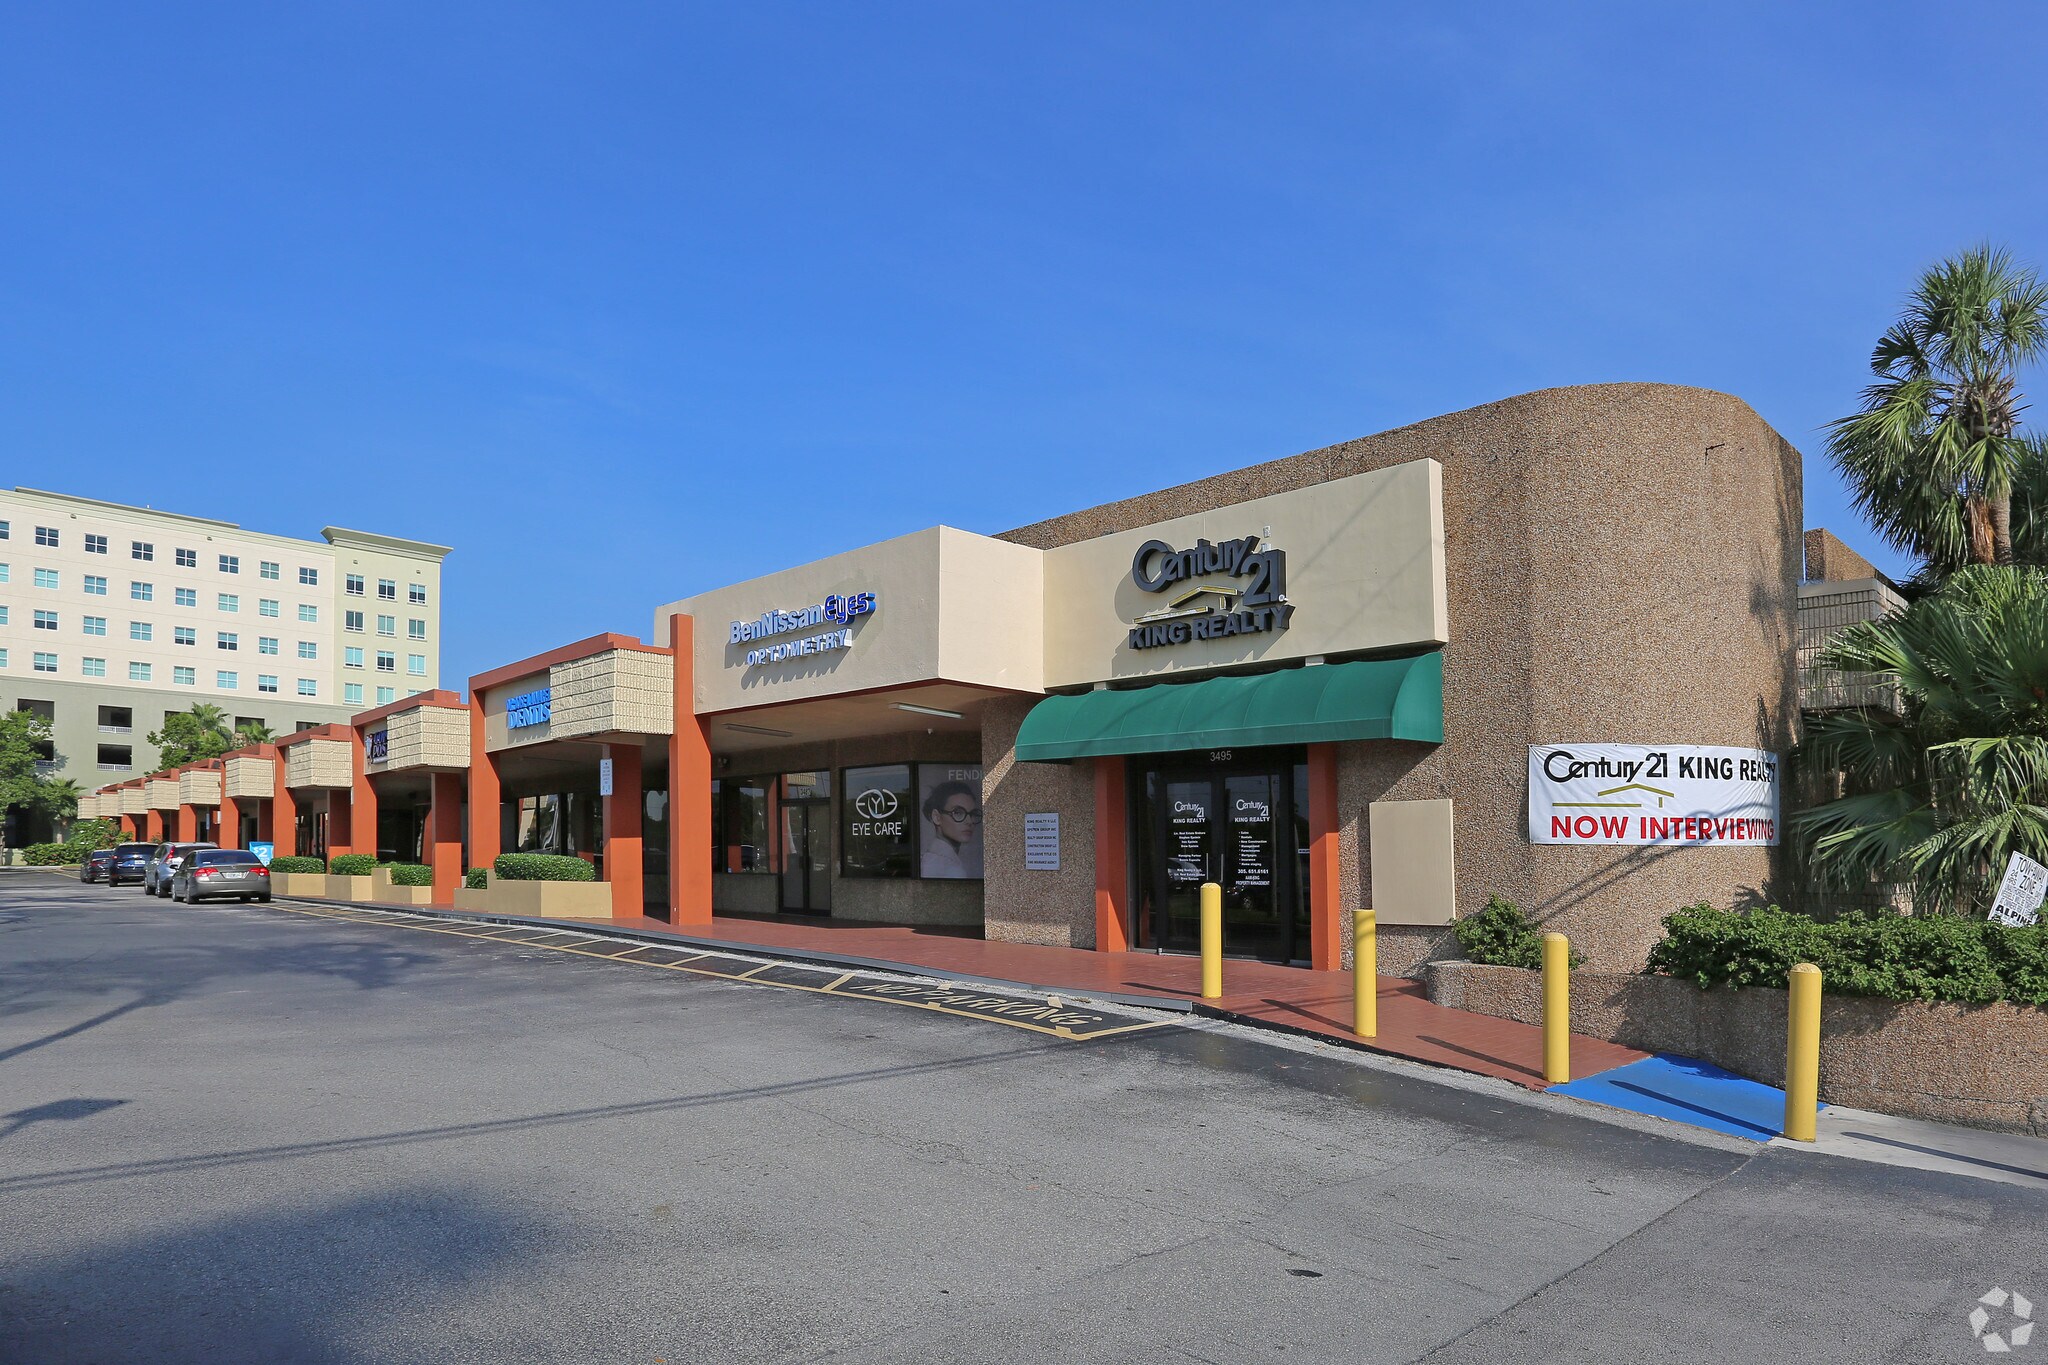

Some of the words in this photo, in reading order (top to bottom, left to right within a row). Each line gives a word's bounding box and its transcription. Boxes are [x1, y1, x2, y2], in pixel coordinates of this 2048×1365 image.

[1132, 535, 1260, 593] Century
[1241, 549, 1286, 606] 21
[1129, 622, 1191, 649] KING
[1192, 604, 1296, 640] REALTY
[747, 628, 853, 667] OPTOMETRY
[1210, 750, 1232, 761] 3495
[1543, 750, 1644, 783] Century
[1646, 753, 1668, 778] 21
[1679, 756, 1733, 780] KING
[1740, 759, 1777, 784] REALTY
[1174, 801, 1200, 812] Century
[1196, 807, 1204, 817] 21
[1235, 799, 1262, 810] Century
[1260, 805, 1269, 816] 21
[852, 823, 871, 836] EYE
[874, 822, 902, 836] CARE
[1551, 815, 1629, 839] NOW
[1640, 816, 1775, 841] INTERVIEWING
[848, 983, 922, 994] NO
[900, 990, 1103, 1025] PARKING
